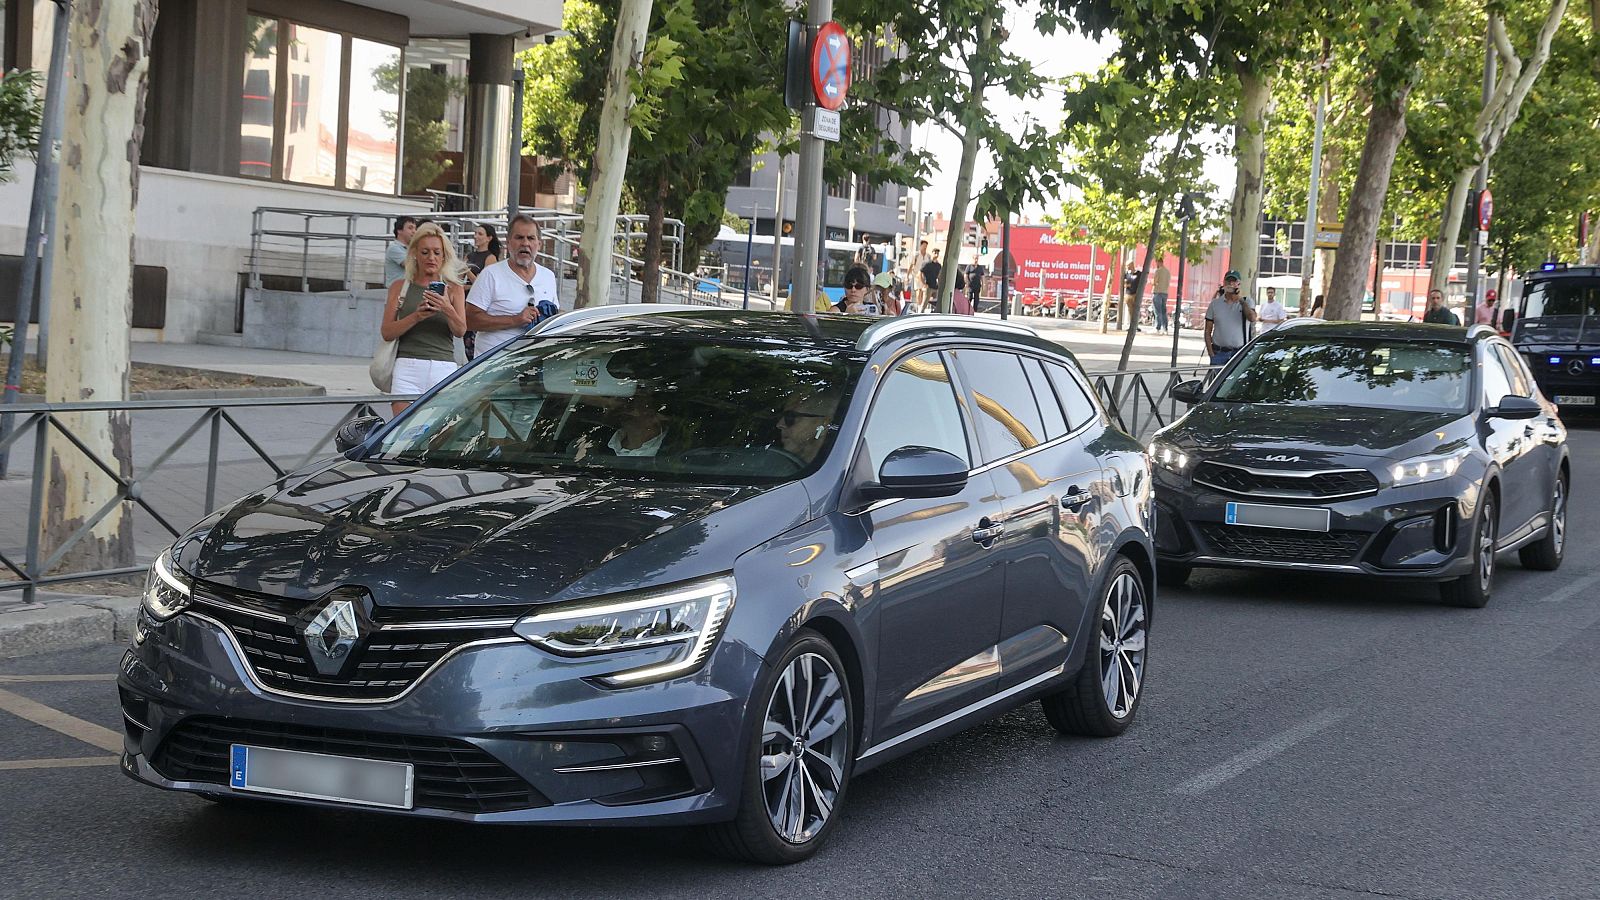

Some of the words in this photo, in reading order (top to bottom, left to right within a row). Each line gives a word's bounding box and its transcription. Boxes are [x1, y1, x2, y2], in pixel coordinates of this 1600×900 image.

[1025, 260, 1040, 268] Haz
[1041, 260, 1050, 268] tu
[1052, 260, 1068, 269] vida
[1060, 271, 1069, 279] tu
[1070, 273, 1102, 282] compa.
[236, 771, 242, 780] E
